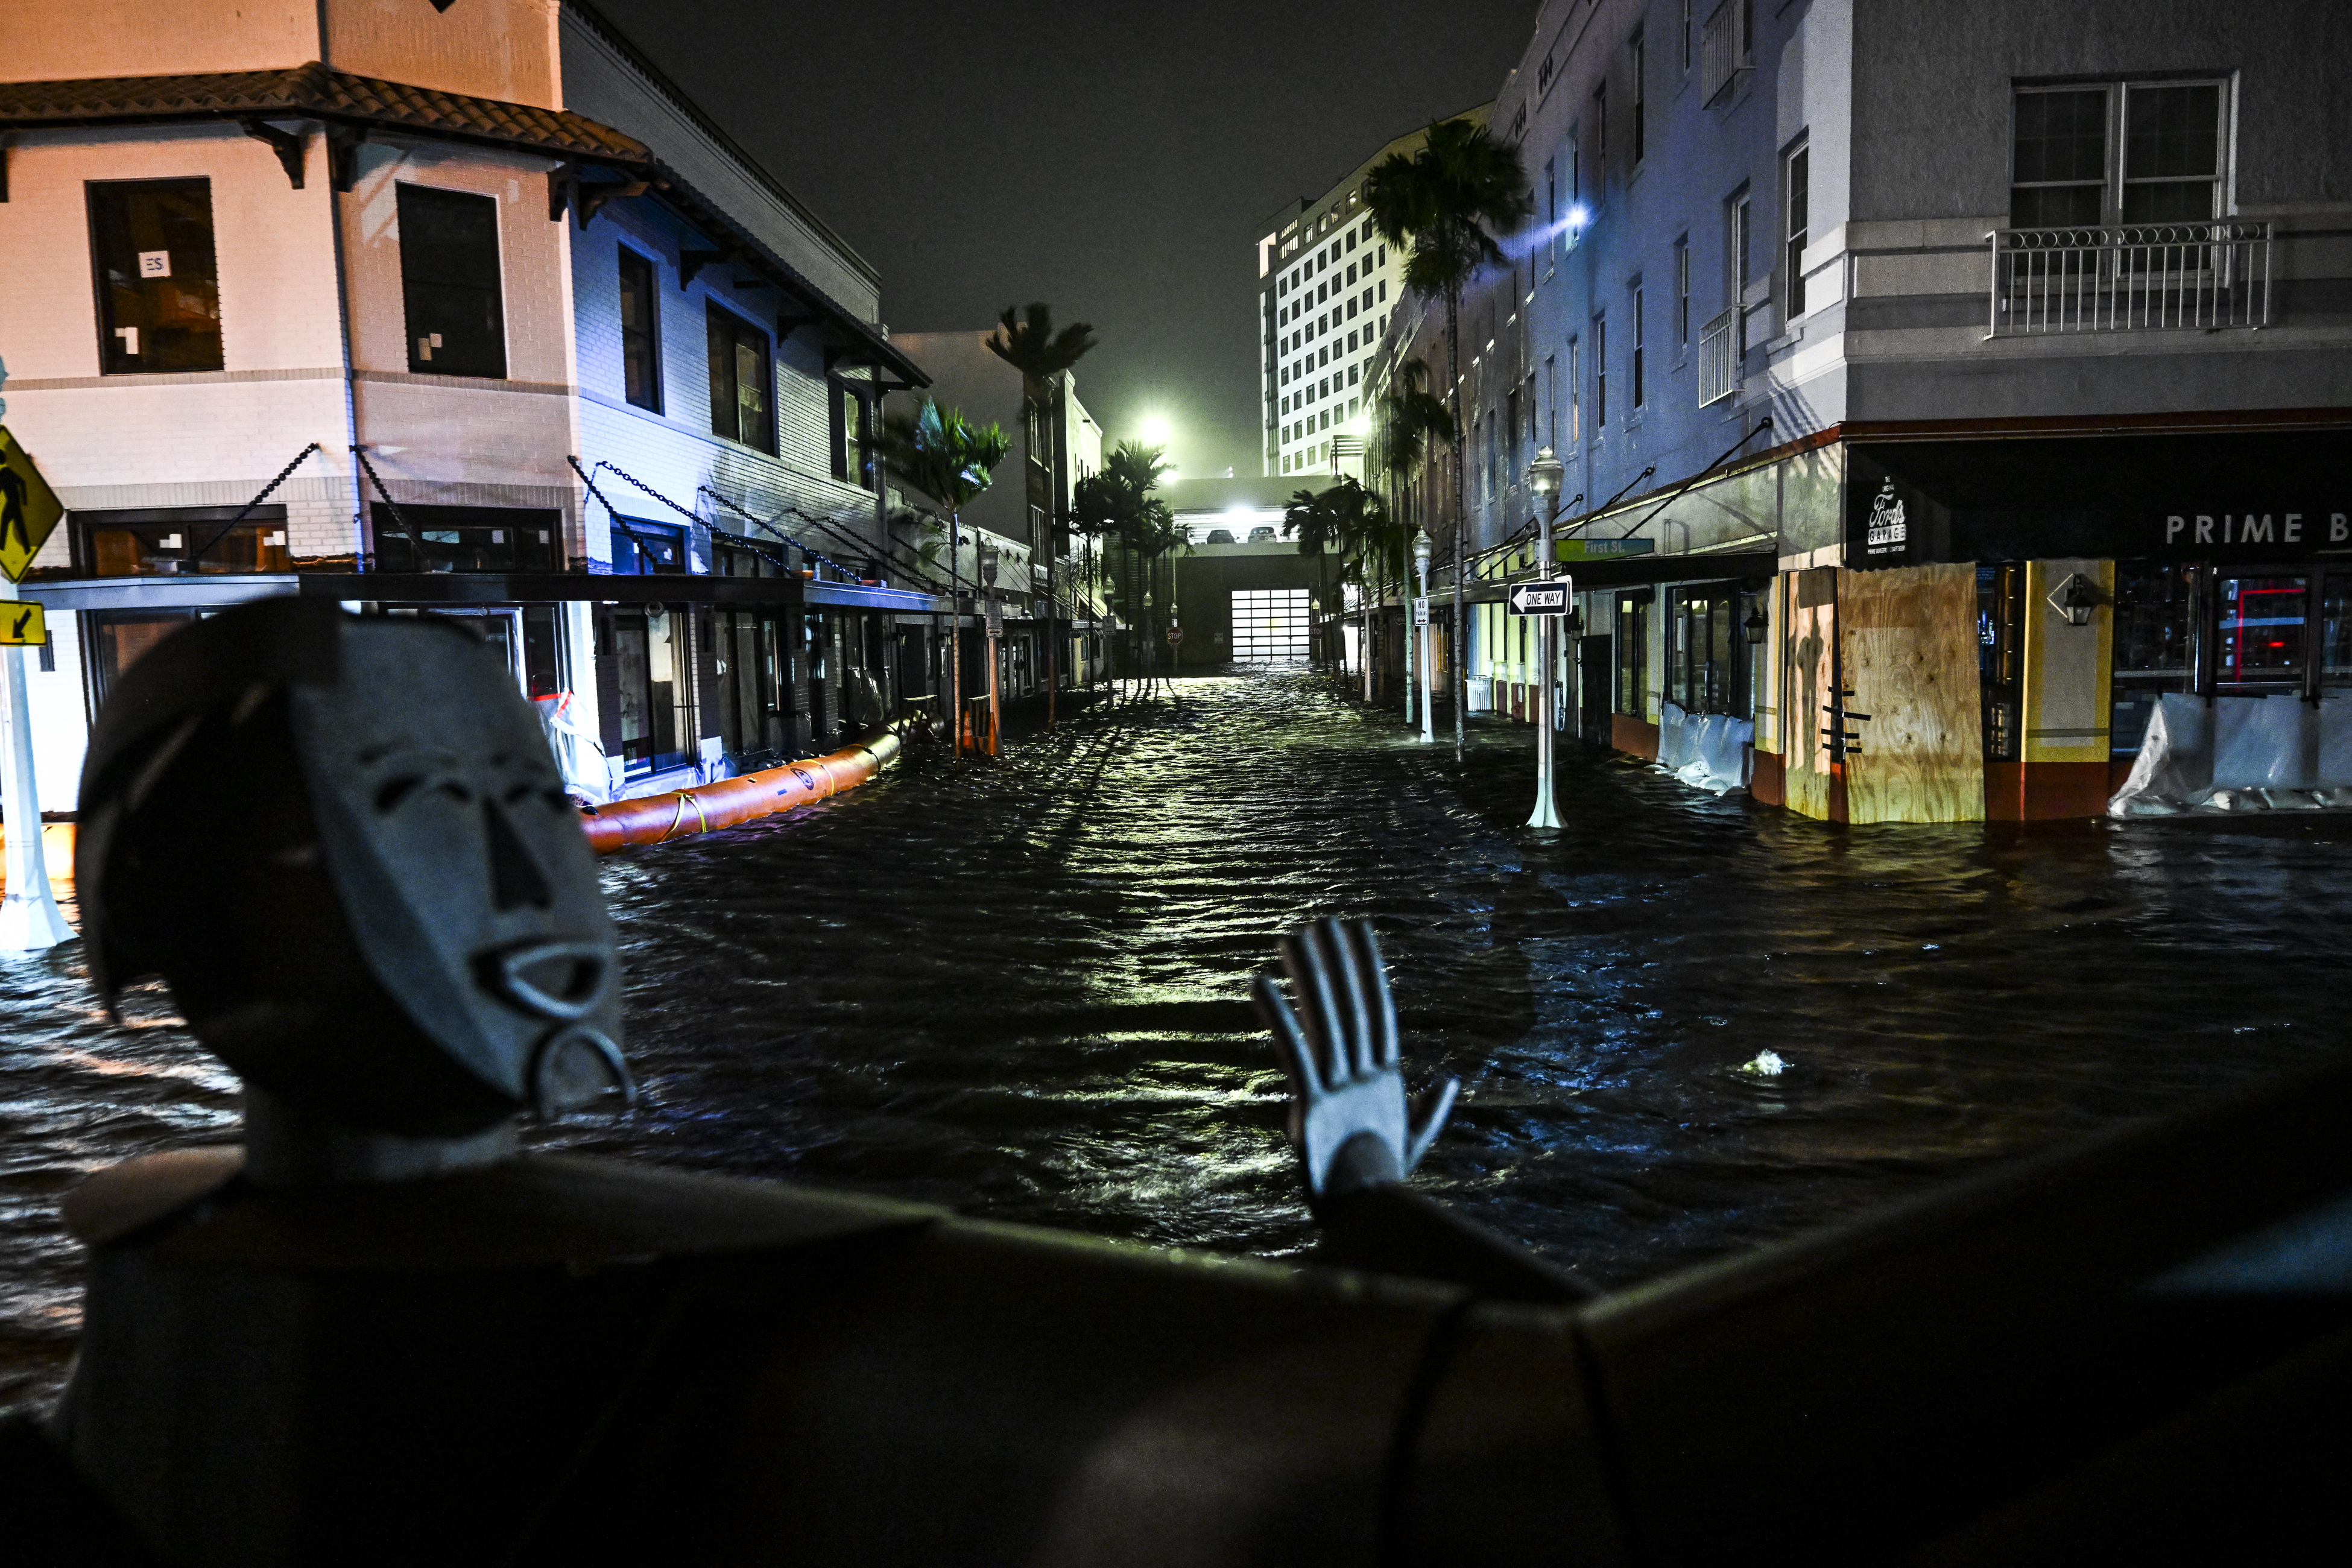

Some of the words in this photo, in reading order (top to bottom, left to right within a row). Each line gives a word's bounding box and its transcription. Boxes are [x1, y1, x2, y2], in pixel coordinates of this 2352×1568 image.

[1870, 528, 1906, 542] GARAGE
[2166, 514, 2302, 543] PRIME
[1584, 540, 1607, 553] First
[1418, 600, 1425, 609] NO
[1526, 593, 1542, 605] ONE
[1544, 592, 1561, 604] WAY
